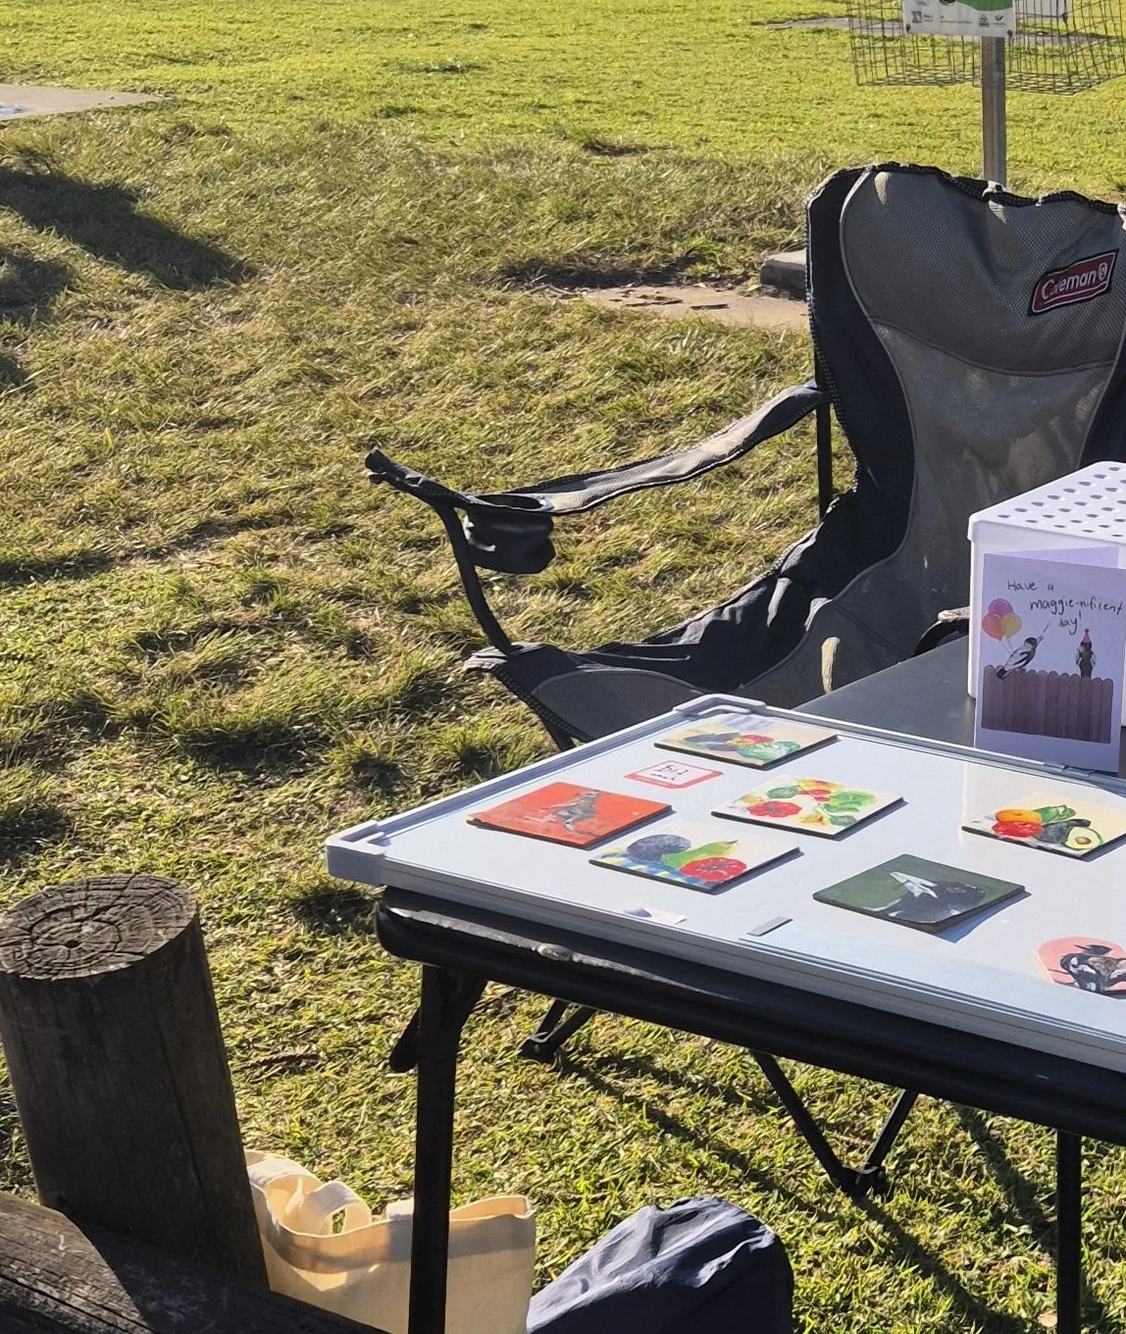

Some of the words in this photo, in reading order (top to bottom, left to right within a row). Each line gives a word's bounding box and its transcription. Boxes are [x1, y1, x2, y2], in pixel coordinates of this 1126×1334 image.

[1007, 579, 1038, 592] Have
[1047, 583, 1055, 592] a
[1029, 596, 1124, 616] maggie-nificent
